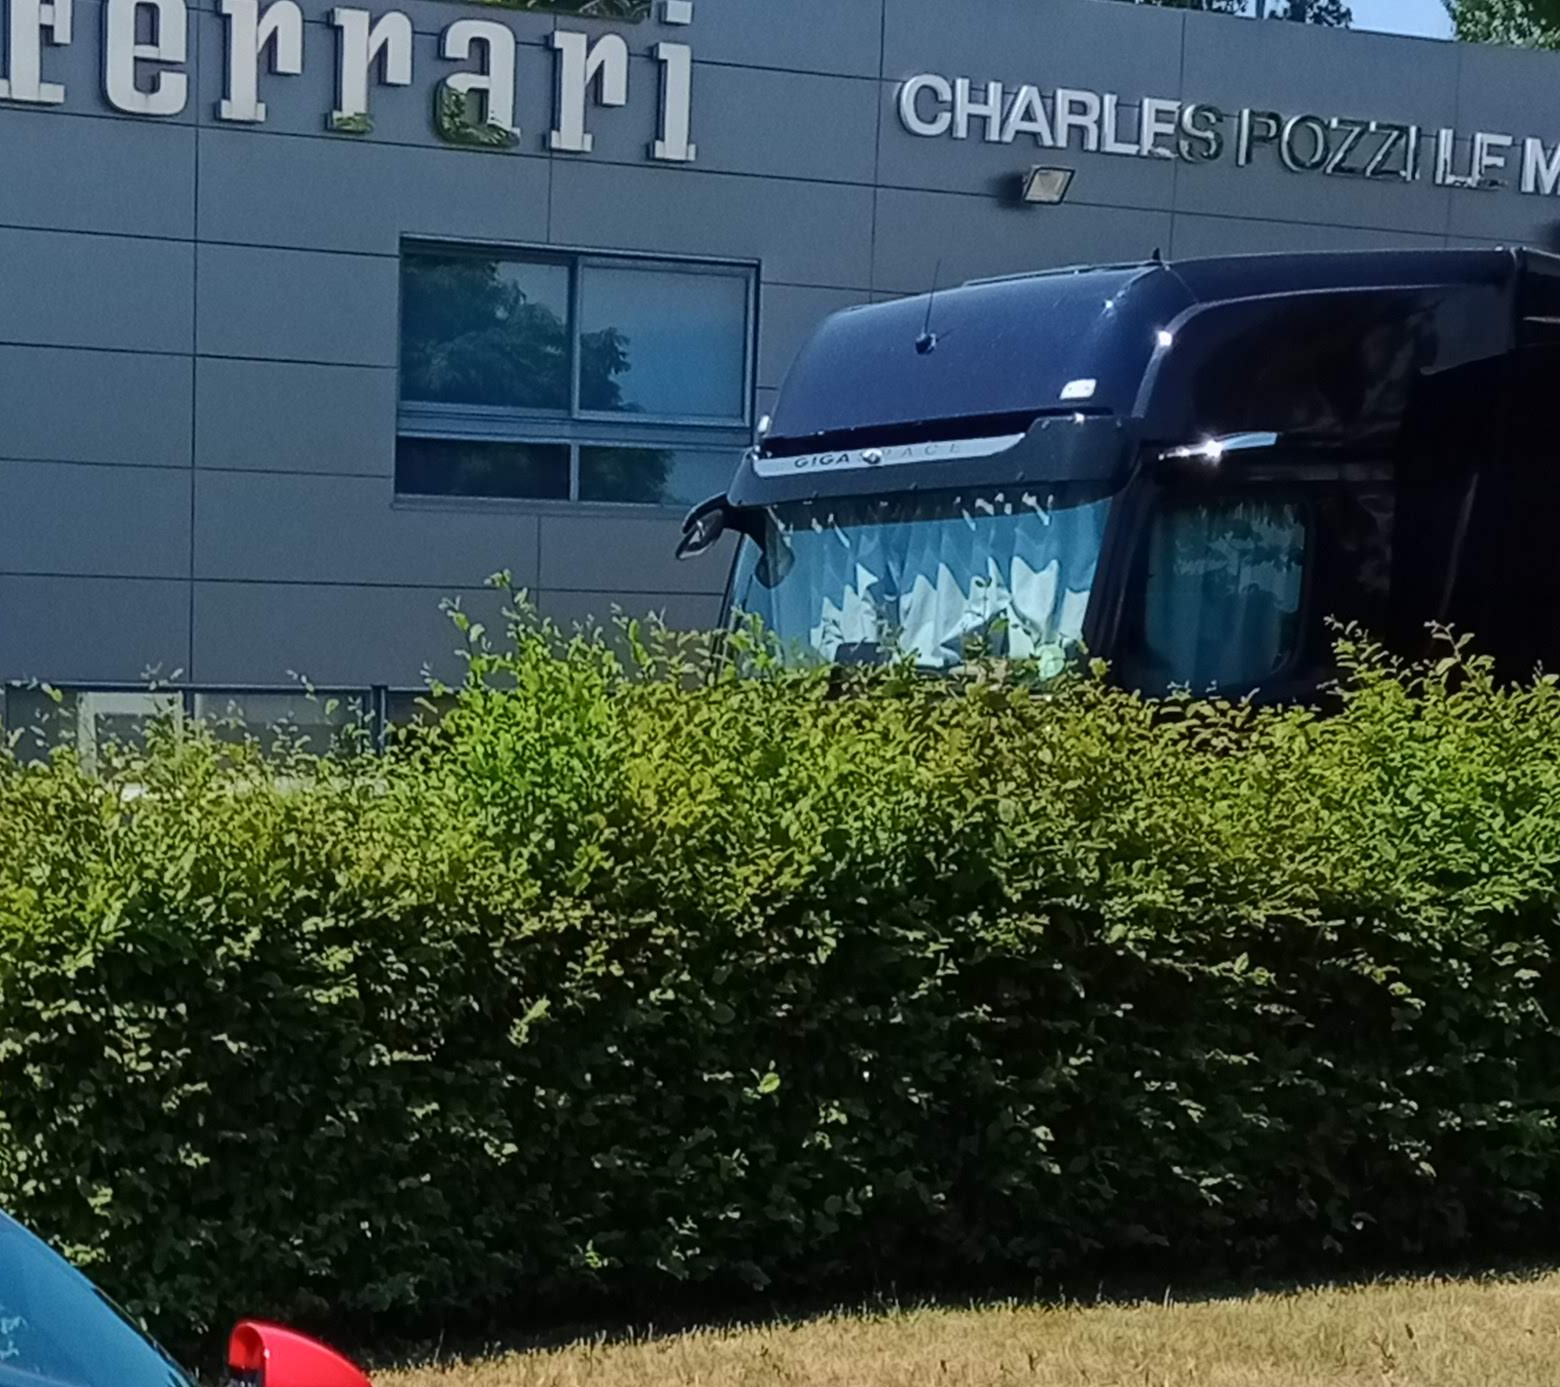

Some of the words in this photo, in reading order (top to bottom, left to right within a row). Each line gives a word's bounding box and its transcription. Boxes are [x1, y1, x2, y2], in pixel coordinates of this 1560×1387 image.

[898, 72, 1224, 164] CHARLES
[1237, 106, 1421, 183] POZZI
[794, 453, 851, 468] GIGA
